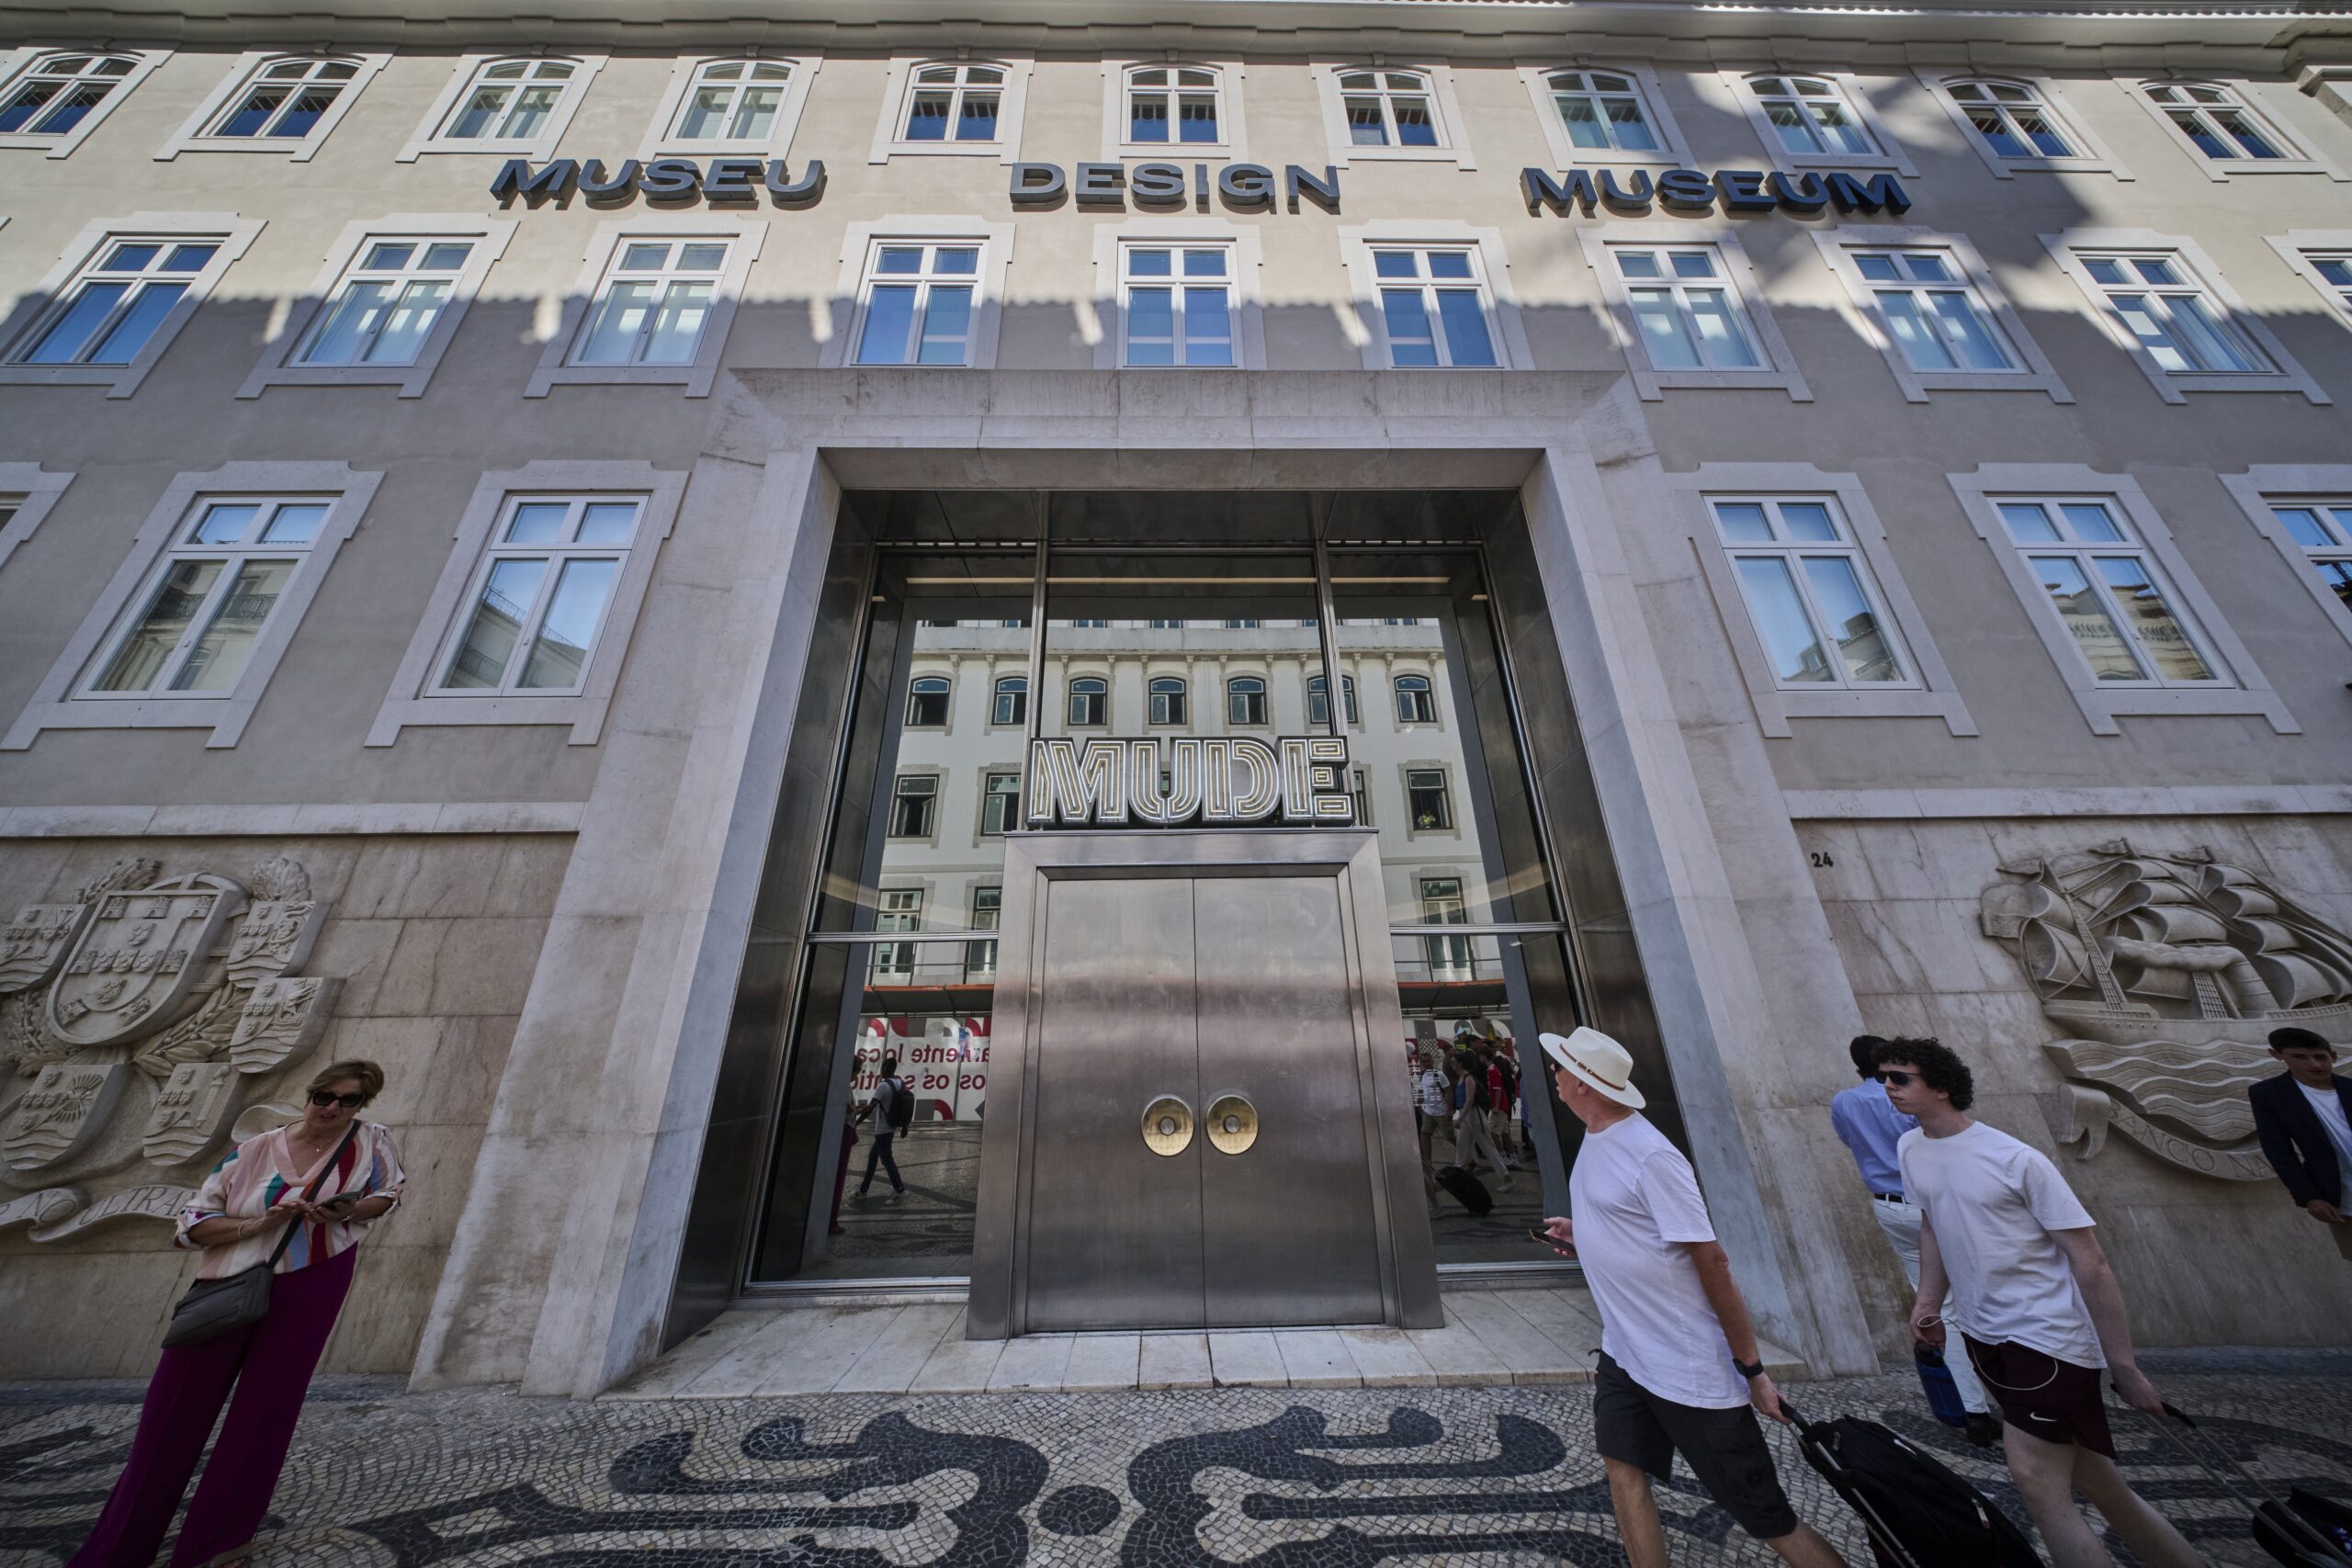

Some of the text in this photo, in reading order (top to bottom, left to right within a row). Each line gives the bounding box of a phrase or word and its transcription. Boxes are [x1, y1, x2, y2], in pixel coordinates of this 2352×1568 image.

[489, 159, 1912, 215] MUSEU DESIGN MUSEUM
[1028, 736, 1355, 826] MUDE
[1811, 852, 1834, 868] 24
[2109, 1101, 2216, 1172] BANCO
